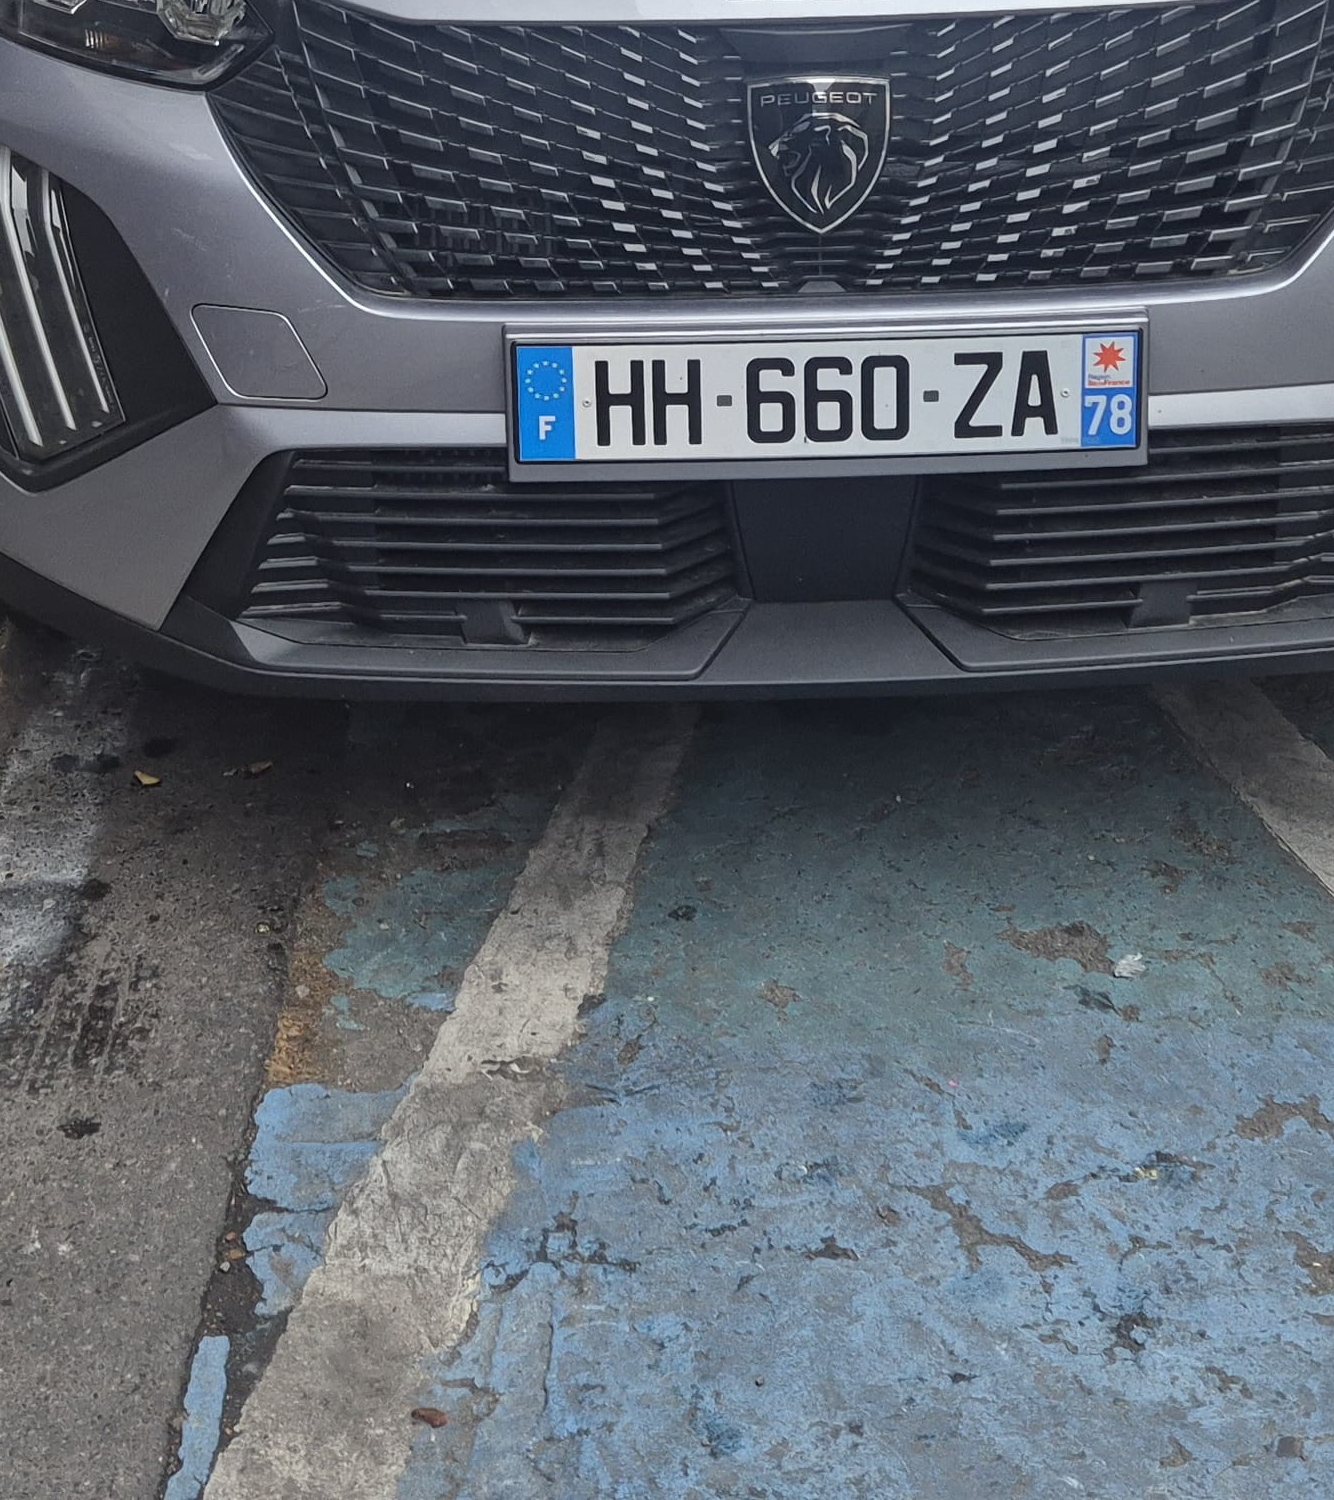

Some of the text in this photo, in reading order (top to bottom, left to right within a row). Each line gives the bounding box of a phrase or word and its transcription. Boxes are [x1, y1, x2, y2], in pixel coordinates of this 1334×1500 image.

[760, 89, 878, 109] PEUGEOT
[593, 351, 1059, 447] HH-660-ZA
[1083, 393, 1133, 436] 78
[537, 416, 557, 441] F
